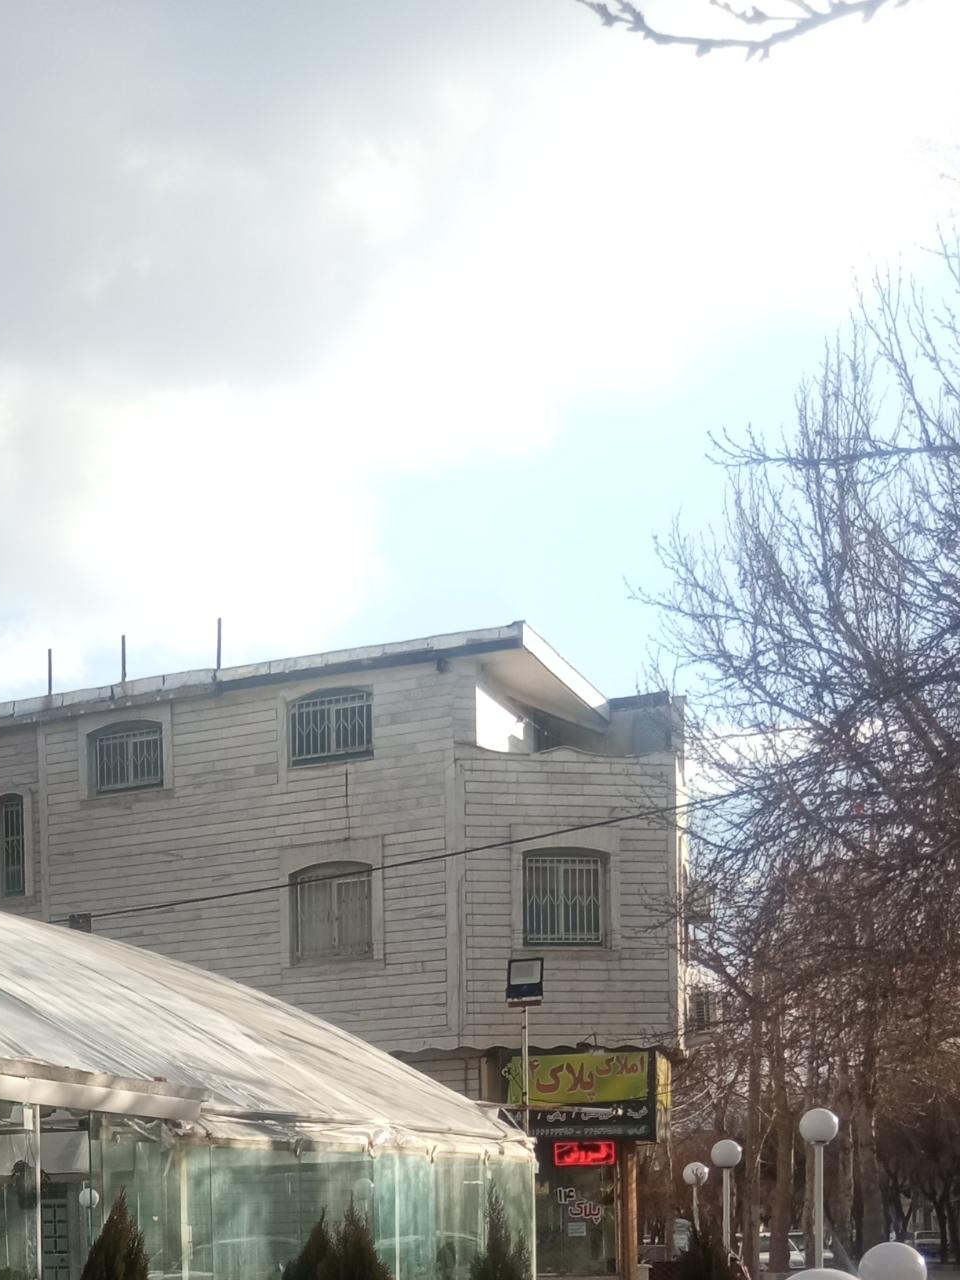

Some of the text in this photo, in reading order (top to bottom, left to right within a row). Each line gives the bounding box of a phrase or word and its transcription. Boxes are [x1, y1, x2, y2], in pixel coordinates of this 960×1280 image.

[595, 1056, 645, 1076] املاک
[535, 1062, 595, 1101] پلاک
[557, 1187, 576, 1204] ۱۴
[568, 1200, 602, 1225] پلاک
